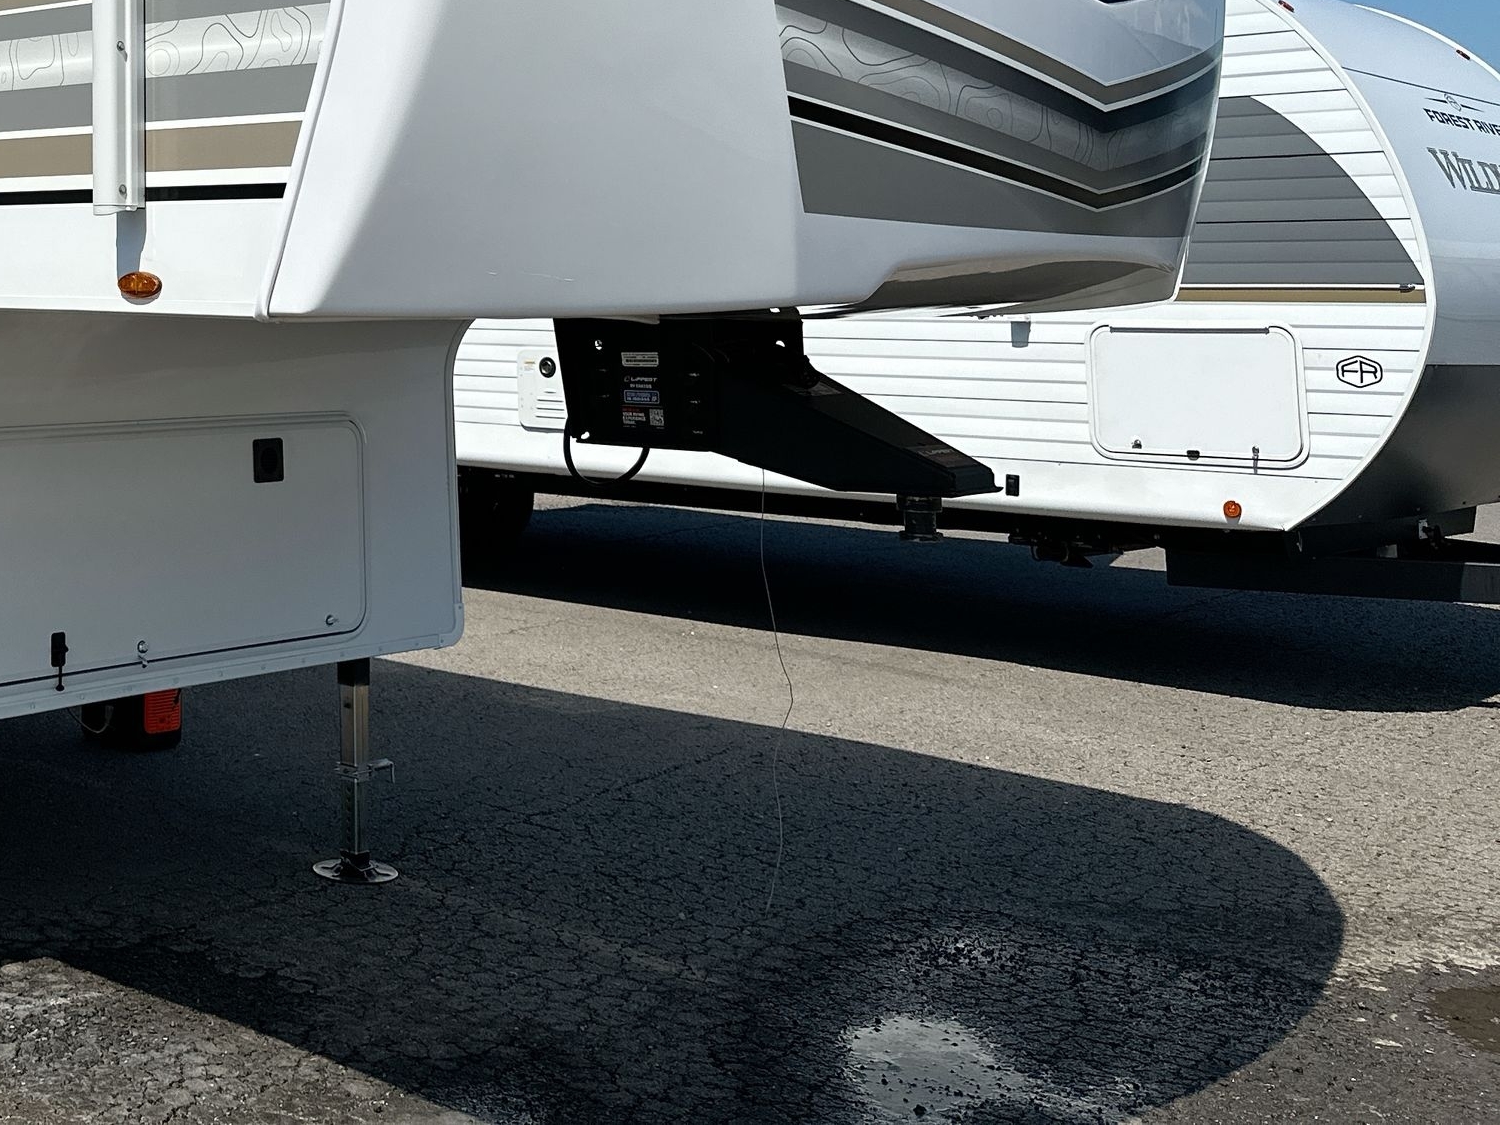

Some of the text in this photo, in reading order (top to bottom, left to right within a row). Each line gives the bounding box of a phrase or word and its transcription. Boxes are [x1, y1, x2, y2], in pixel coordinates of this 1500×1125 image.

[1422, 107, 1500, 136] FOREST RIVE
[1425, 146, 1500, 195] WILD
